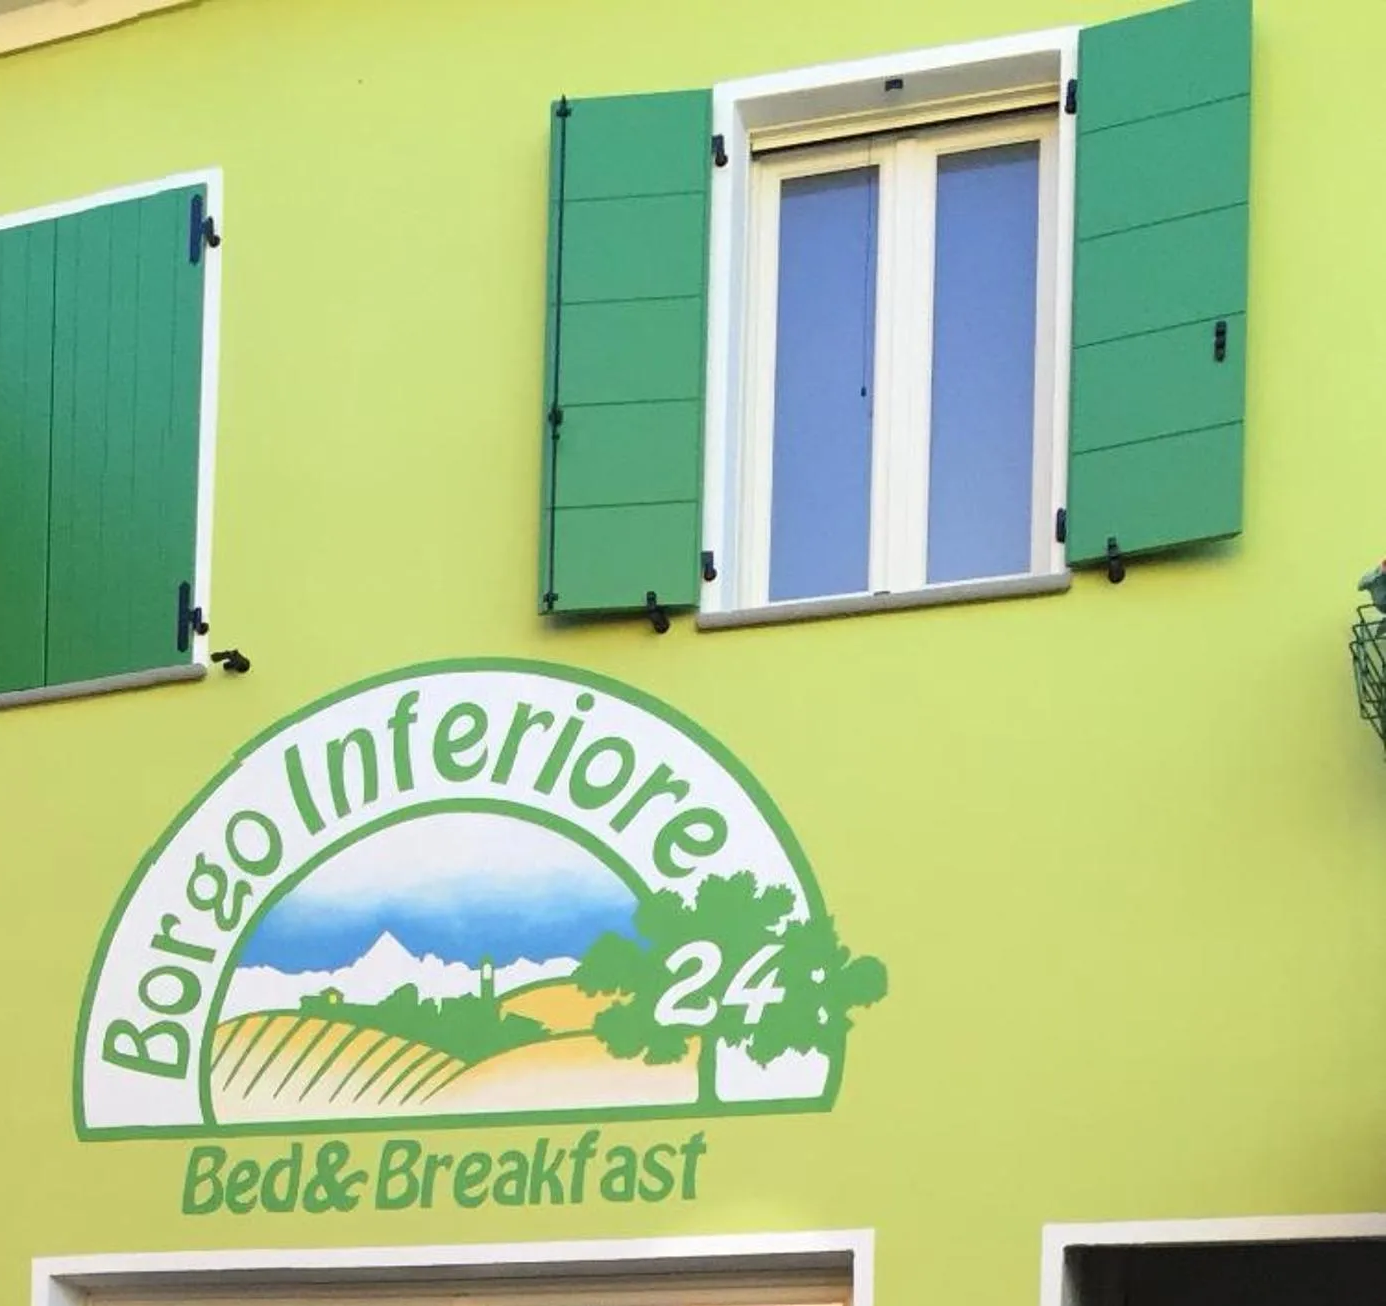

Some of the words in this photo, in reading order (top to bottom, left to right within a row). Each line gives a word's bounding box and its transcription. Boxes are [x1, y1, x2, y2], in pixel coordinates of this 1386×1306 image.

[101, 809, 284, 1081] Borgo
[283, 690, 729, 880] Inferiore
[653, 940, 787, 1026] 24
